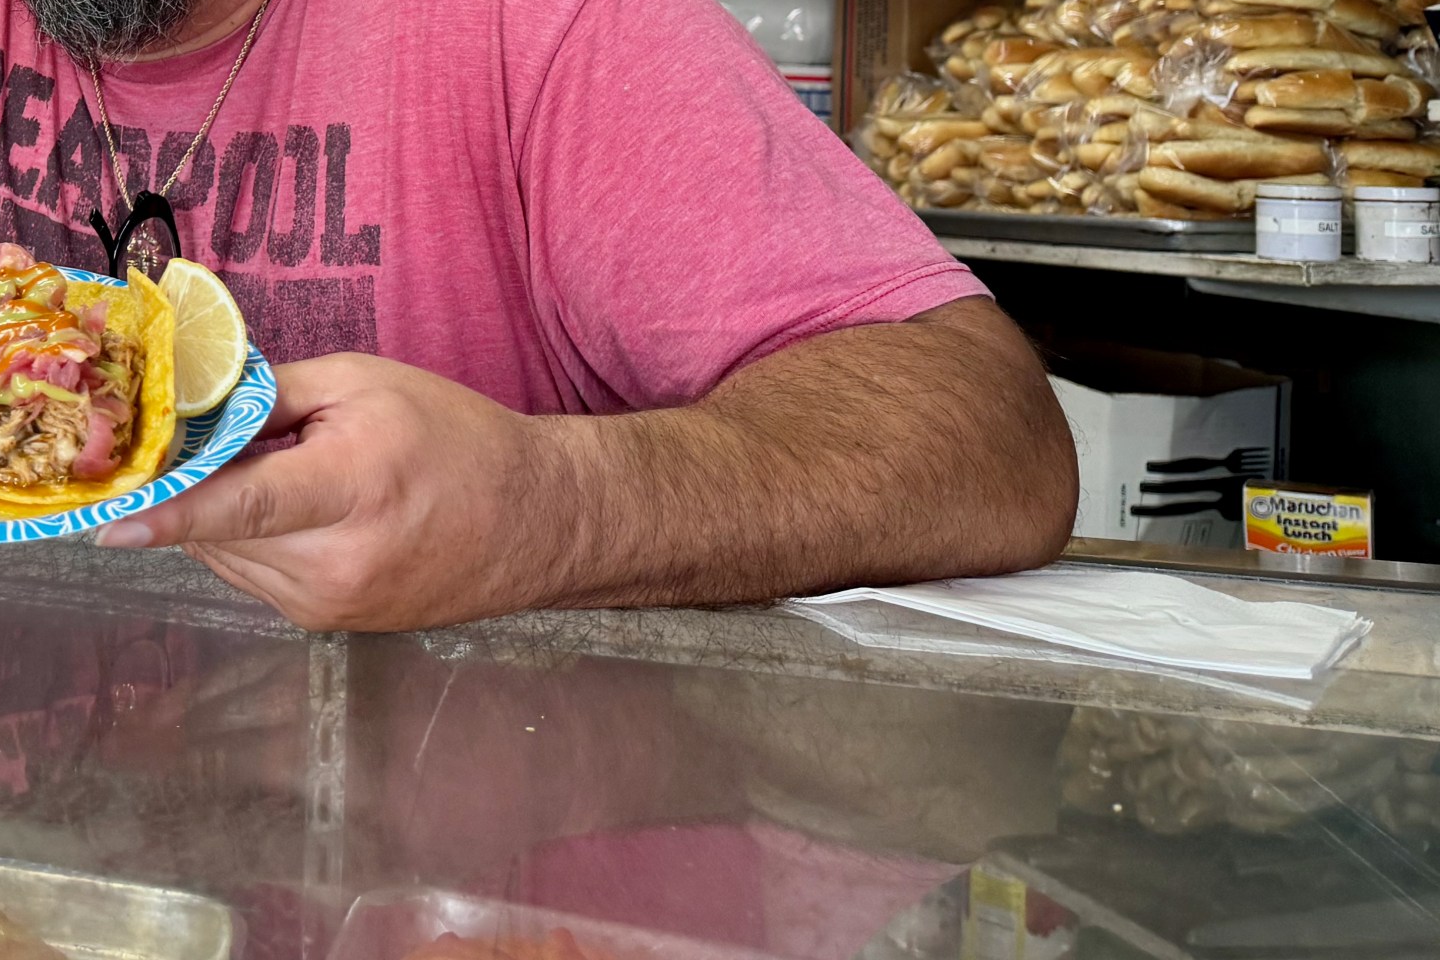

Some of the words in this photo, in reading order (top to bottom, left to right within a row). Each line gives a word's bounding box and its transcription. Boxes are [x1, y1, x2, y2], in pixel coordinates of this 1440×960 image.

[1318, 221, 1339, 233] SALT
[1268, 497, 1361, 520] Maruchan
[1276, 515, 1339, 531] Instant
[1283, 526, 1332, 541] Lunch
